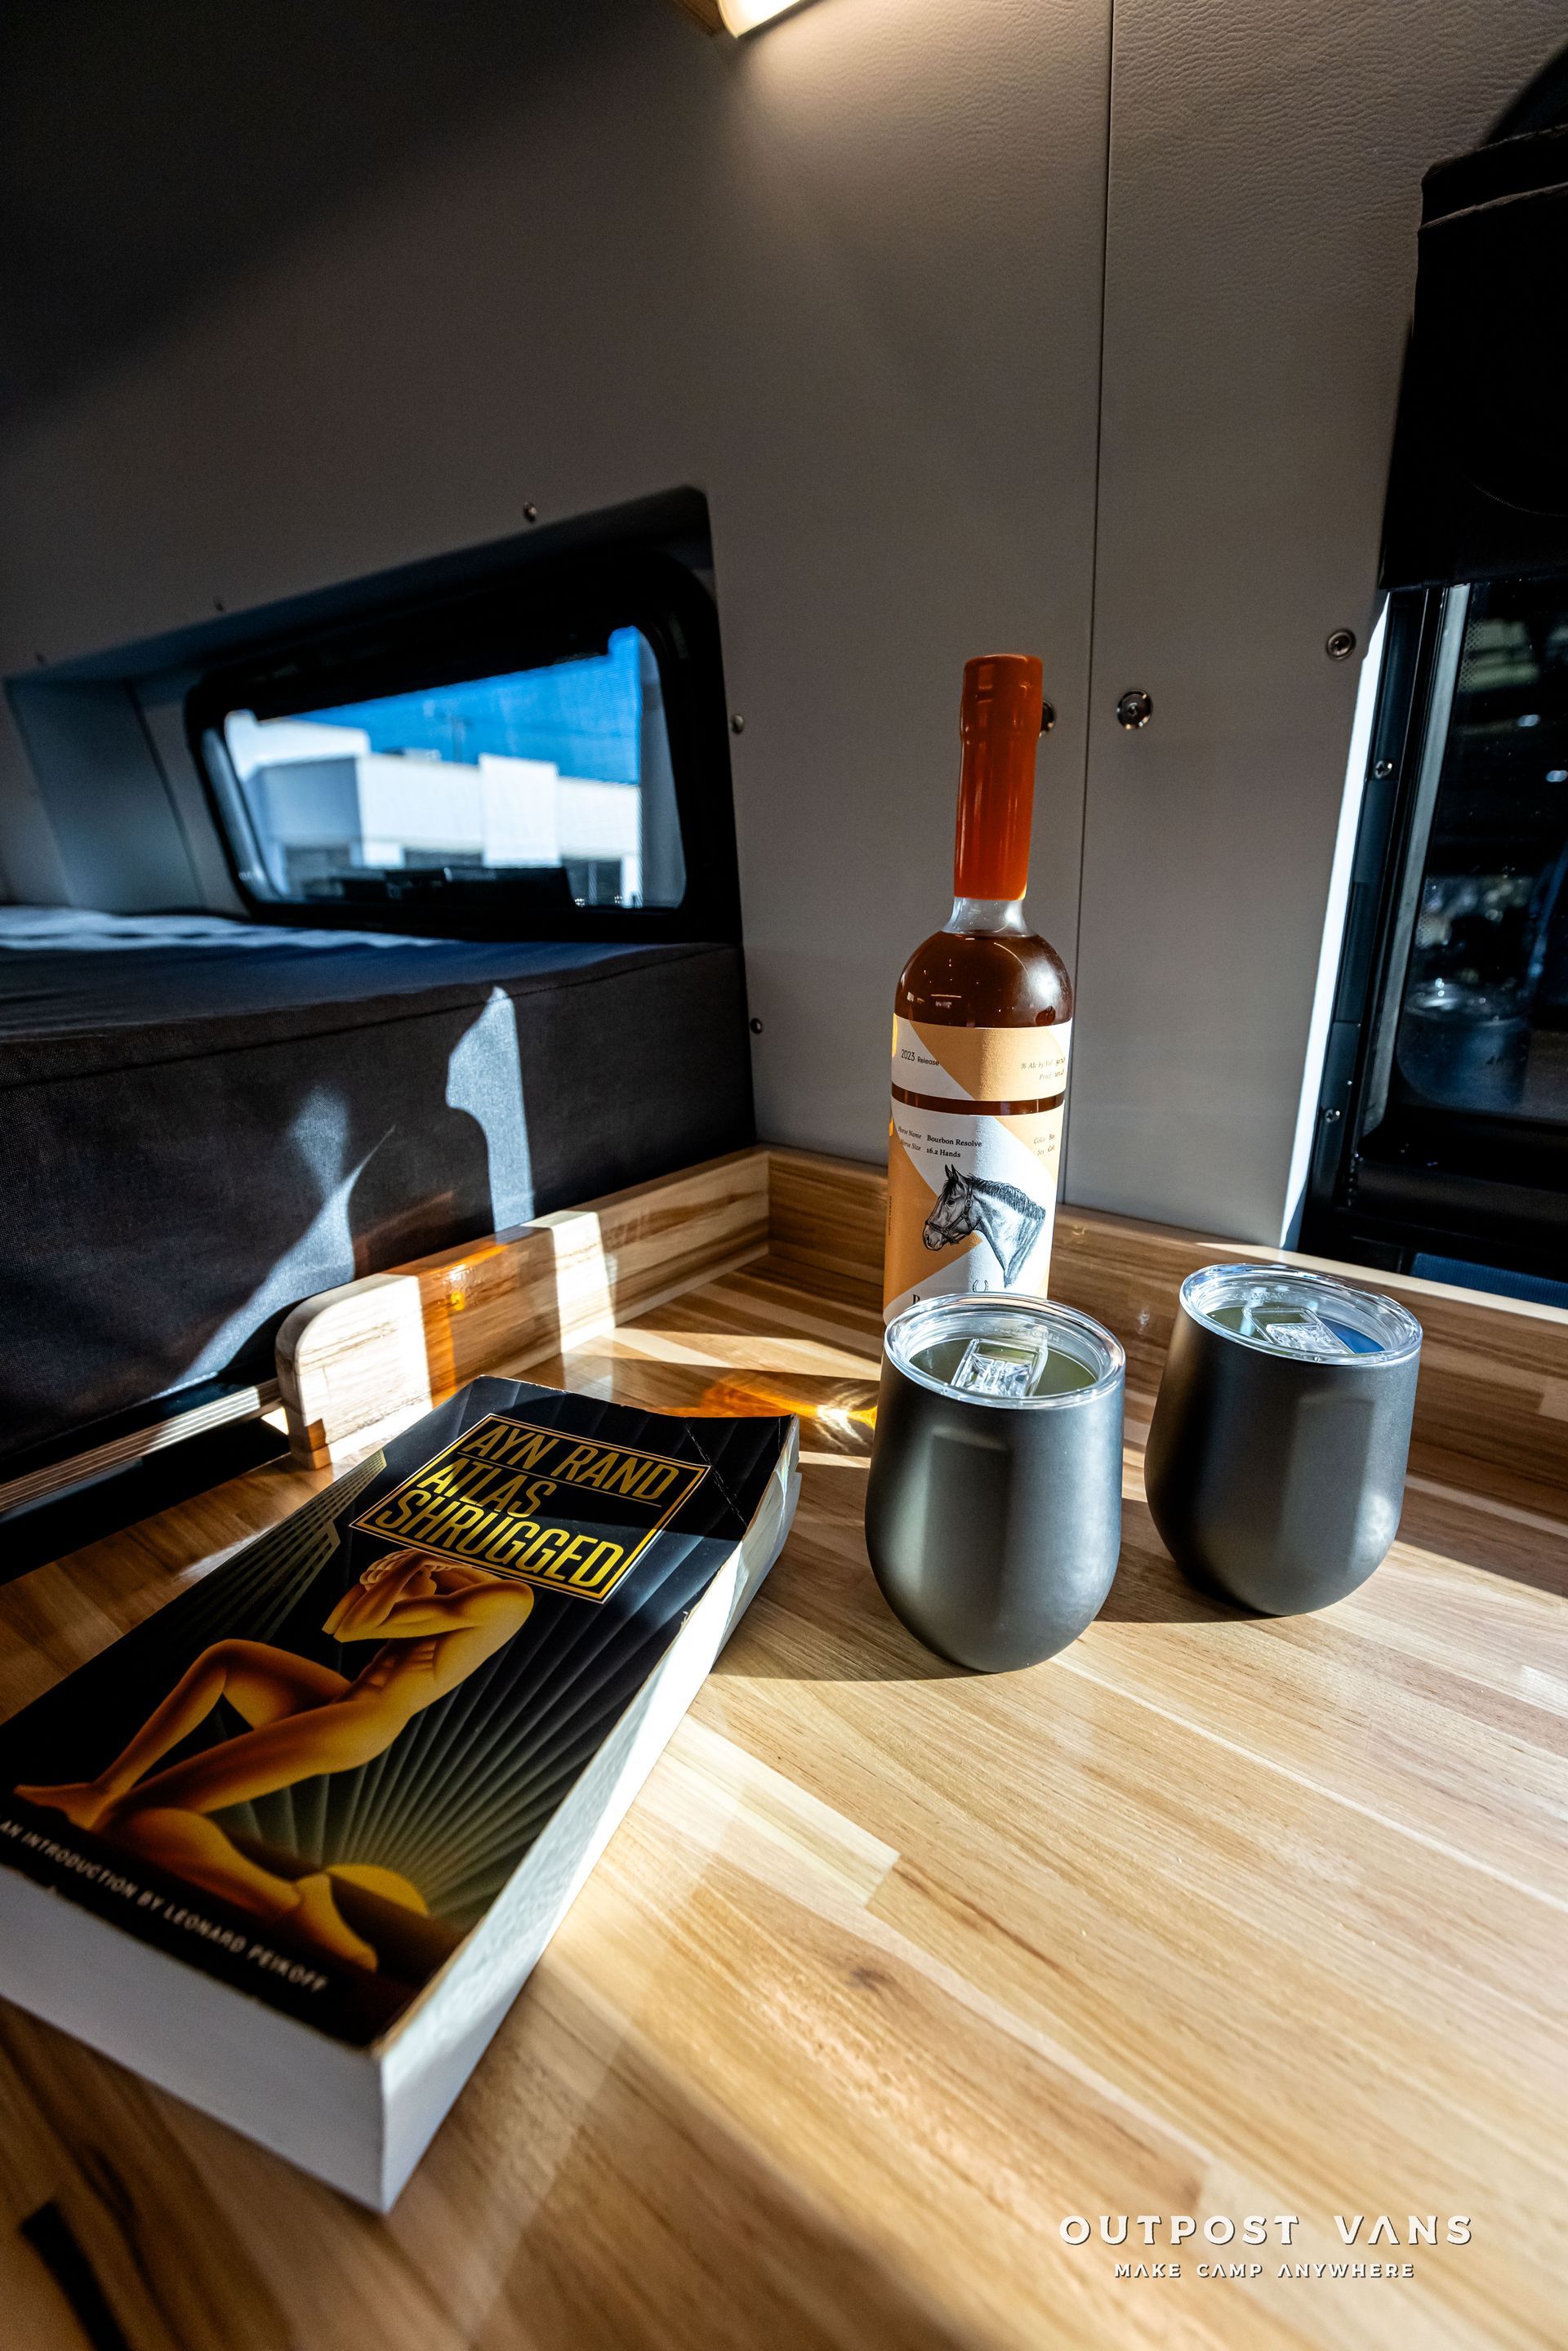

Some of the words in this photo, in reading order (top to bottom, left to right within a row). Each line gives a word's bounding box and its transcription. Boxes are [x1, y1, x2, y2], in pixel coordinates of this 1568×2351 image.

[901, 1049, 915, 1062] 2023
[917, 1056, 940, 1066] Release
[908, 1130, 922, 1139] Name
[927, 1134, 954, 1146] Bourbon
[956, 1138, 982, 1147] Resolve
[911, 1143, 921, 1151] Size
[940, 1149, 961, 1158] Hands
[416, 1458, 557, 1519] ATLAS
[462, 1424, 561, 1470] AYN
[550, 1445, 679, 1500] RAND
[376, 1489, 625, 1587] SHRUGGED
[0, 1819, 24, 1838] AN
[20, 1829, 138, 1899] INTRODUCTION
[137, 1890, 164, 1912] BY
[163, 1903, 247, 1954] LEONARD
[247, 1944, 328, 1993] PEIKOFF
